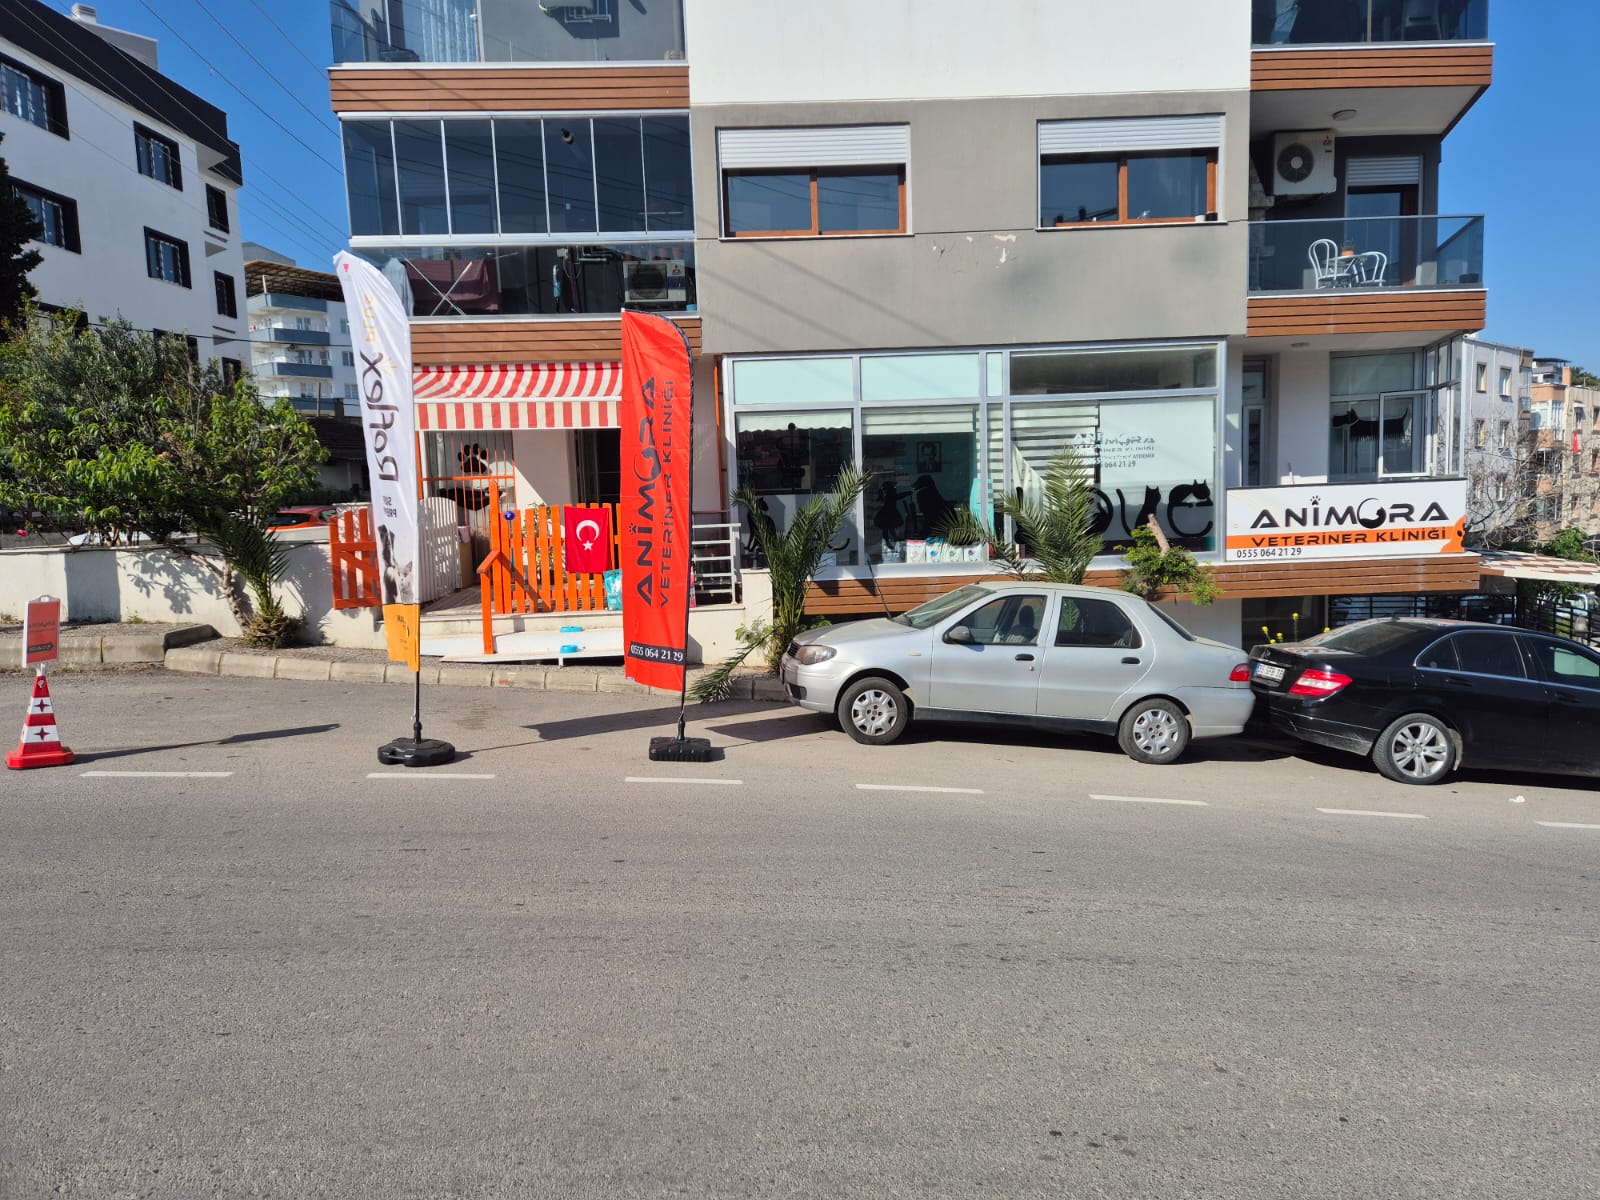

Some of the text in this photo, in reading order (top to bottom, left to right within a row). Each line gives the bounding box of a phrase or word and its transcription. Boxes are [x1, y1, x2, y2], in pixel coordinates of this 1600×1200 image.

[1251, 527, 1446, 547] VETERİNER KLİNİĞİ
[1236, 547, 1302, 559] 0555 064 21 29
[645, 647, 659, 658] 064
[661, 649, 671, 660] 21
[672, 651, 684, 661] 29
